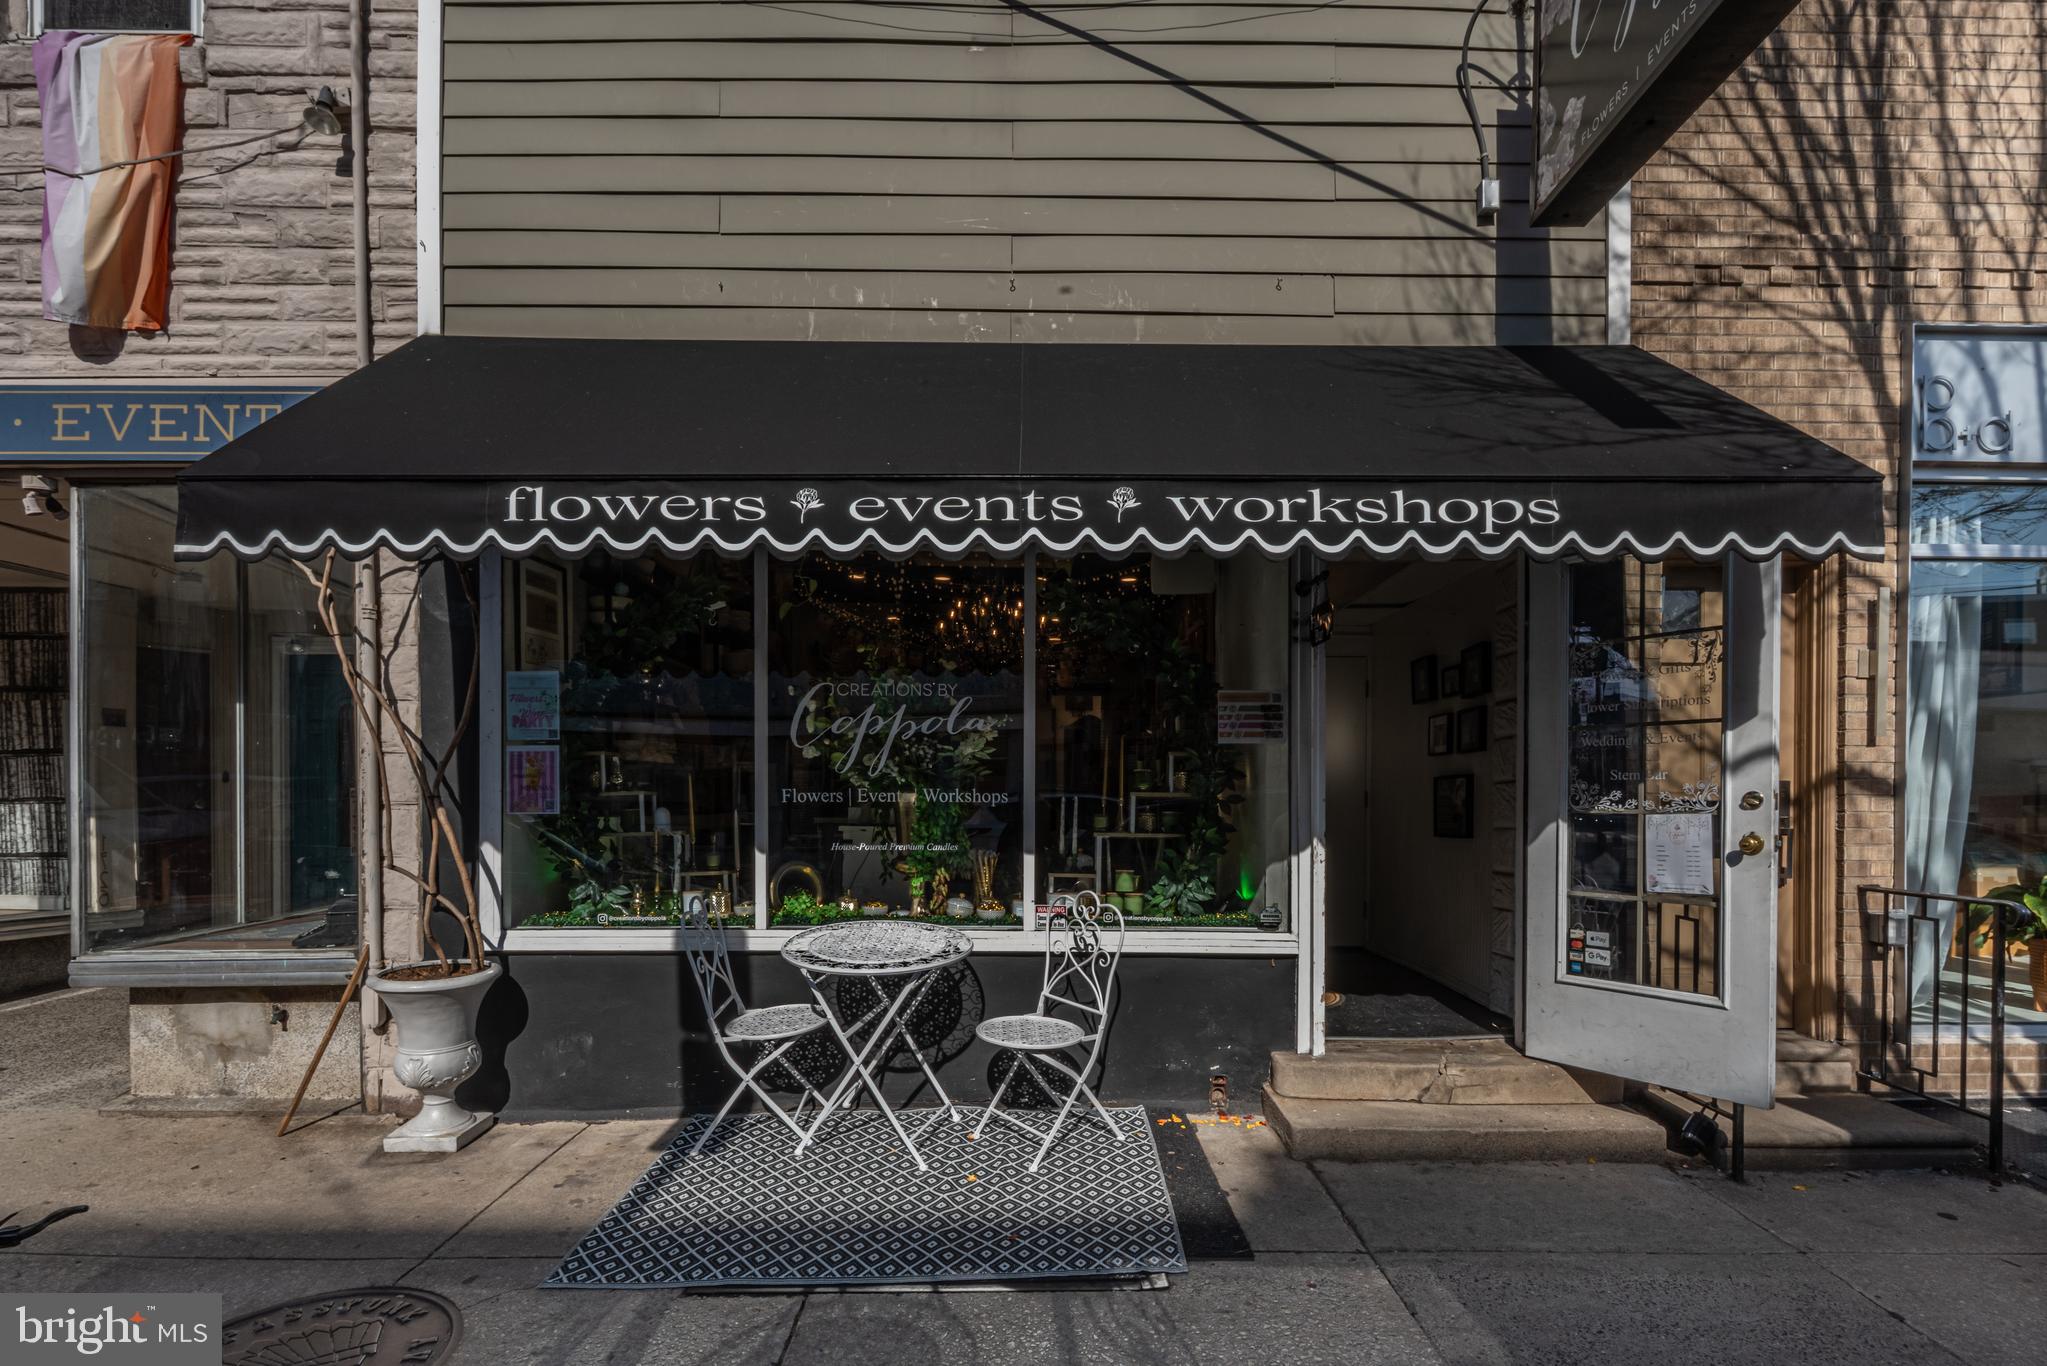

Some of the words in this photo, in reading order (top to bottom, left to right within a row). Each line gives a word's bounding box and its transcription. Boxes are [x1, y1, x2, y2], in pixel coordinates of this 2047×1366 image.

[1581, 81, 1629, 145] FLOWERS
[1647, 0, 1697, 66] EVENTS
[503, 485, 767, 523] flowers
[848, 489, 1085, 523] events
[1165, 488, 1561, 535] workshops
[835, 682, 932, 697] CREATIONS
[938, 683, 959, 697] BY
[789, 682, 998, 777] Coppola
[1580, 734, 1636, 748] Wedding
[1609, 769, 1641, 781] Stem
[781, 788, 844, 804] Flowers
[857, 788, 906, 804] Event
[924, 787, 1009, 808] Workshops
[830, 842, 889, 852] House-Poured
[889, 842, 925, 852] Premium
[926, 842, 959, 852] Candles
[1588, 951, 1595, 960] G
[1595, 953, 1608, 962] Pay
